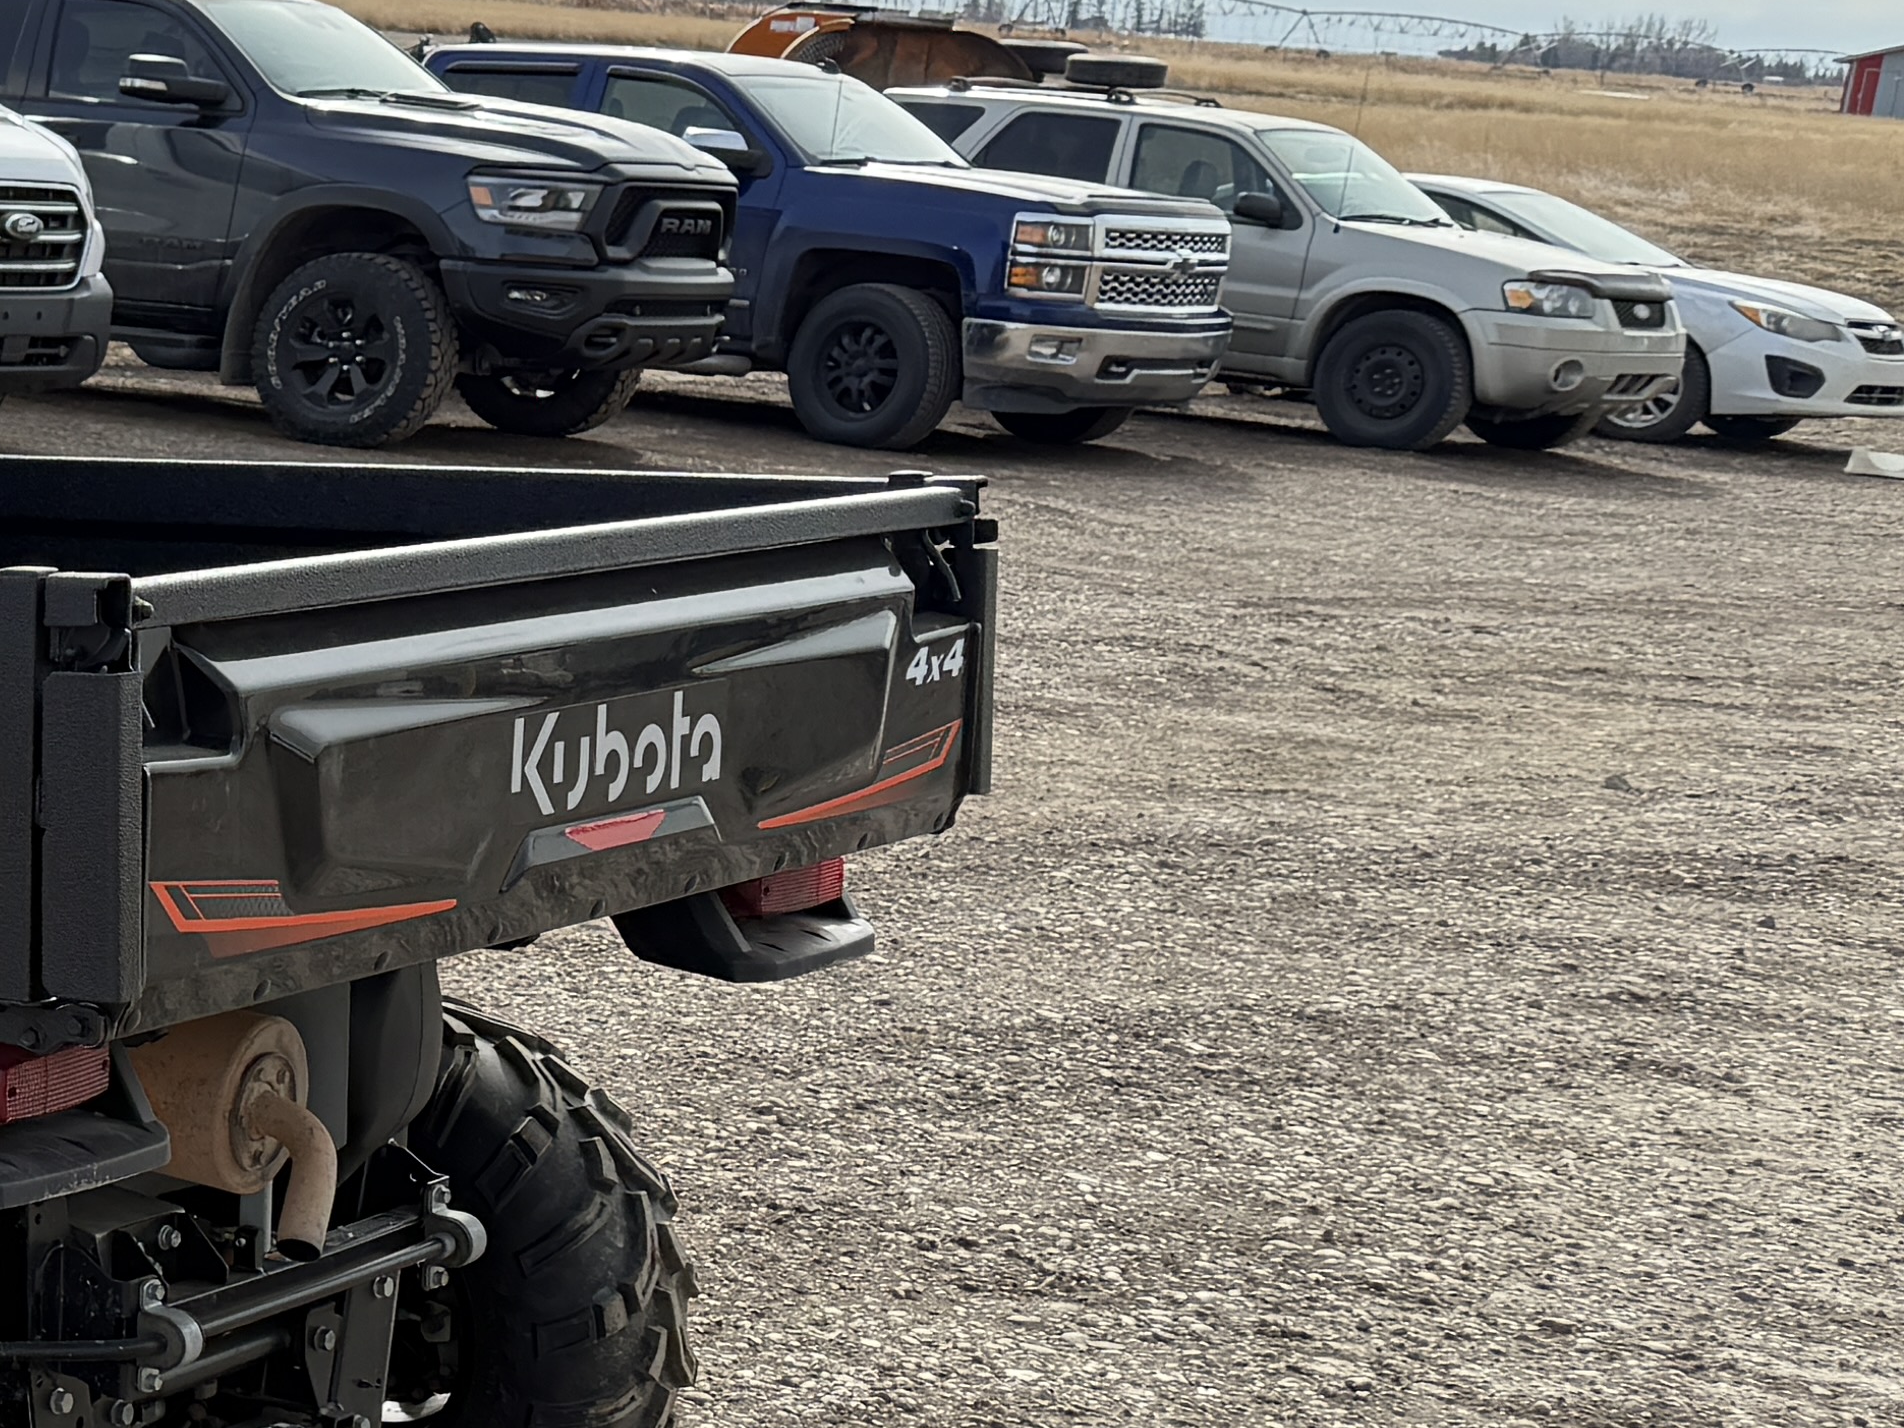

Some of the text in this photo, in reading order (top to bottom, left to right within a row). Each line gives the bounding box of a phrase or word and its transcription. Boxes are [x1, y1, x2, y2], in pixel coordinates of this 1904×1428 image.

[660, 217, 712, 235] RAM
[905, 638, 966, 686] 4x4
[511, 690, 723, 816] Kubota
